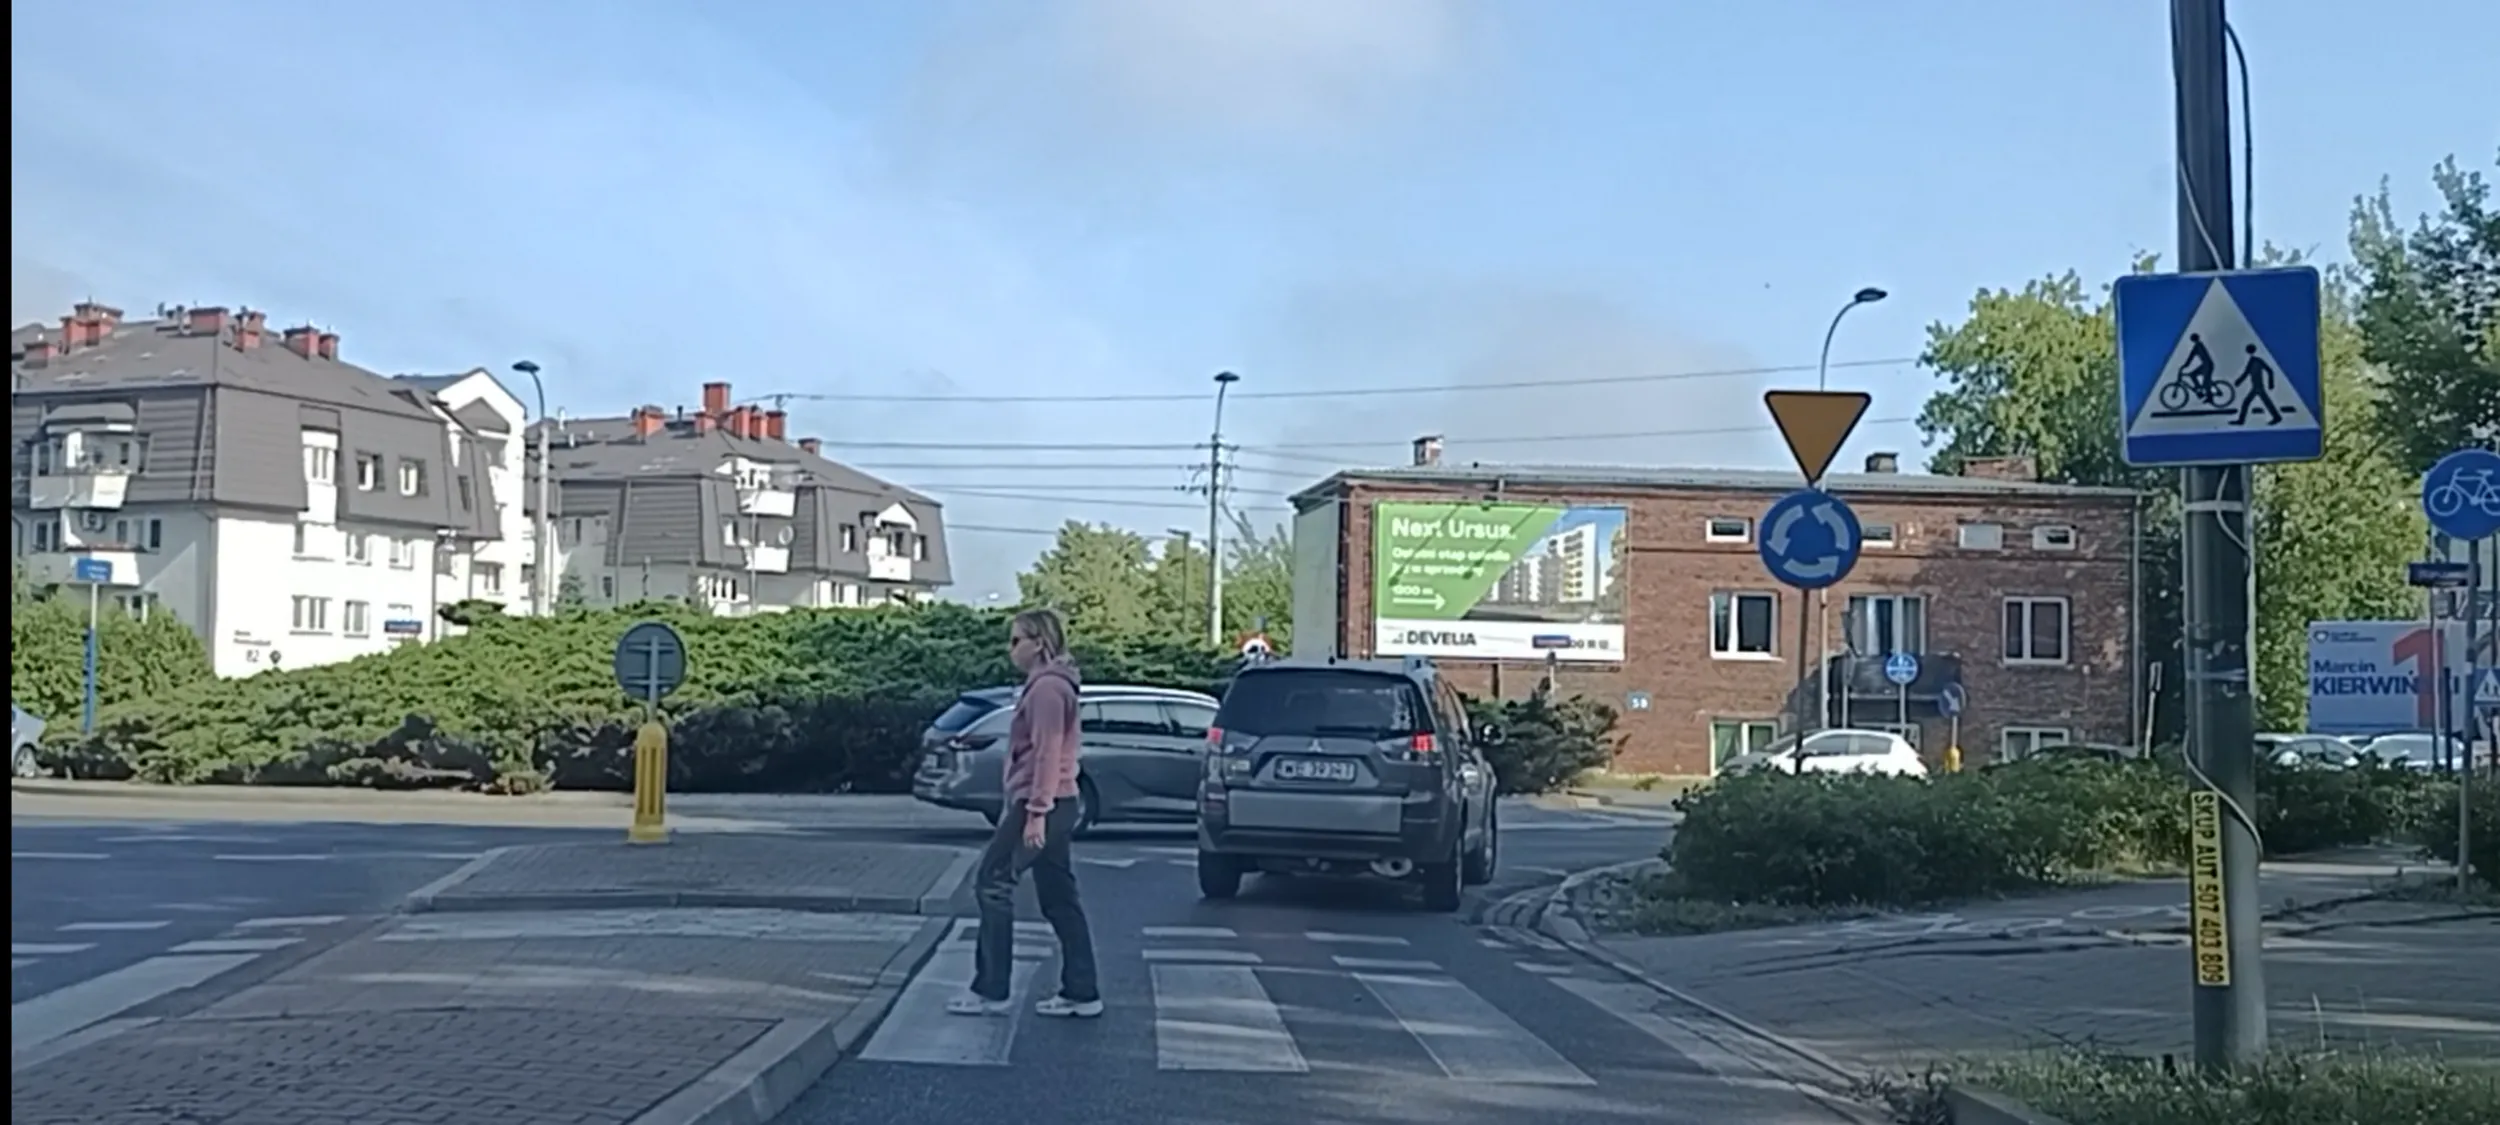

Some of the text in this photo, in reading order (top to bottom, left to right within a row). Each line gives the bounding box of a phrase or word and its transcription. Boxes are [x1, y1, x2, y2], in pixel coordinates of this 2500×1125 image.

[1391, 517, 1444, 538] Next
[1406, 631, 1478, 647] DEVELIA
[2313, 657, 2377, 674] Marcin
[2313, 669, 2460, 696] KIERWIŃI
[2194, 794, 2224, 984] SKUP AUT 507 403 809
